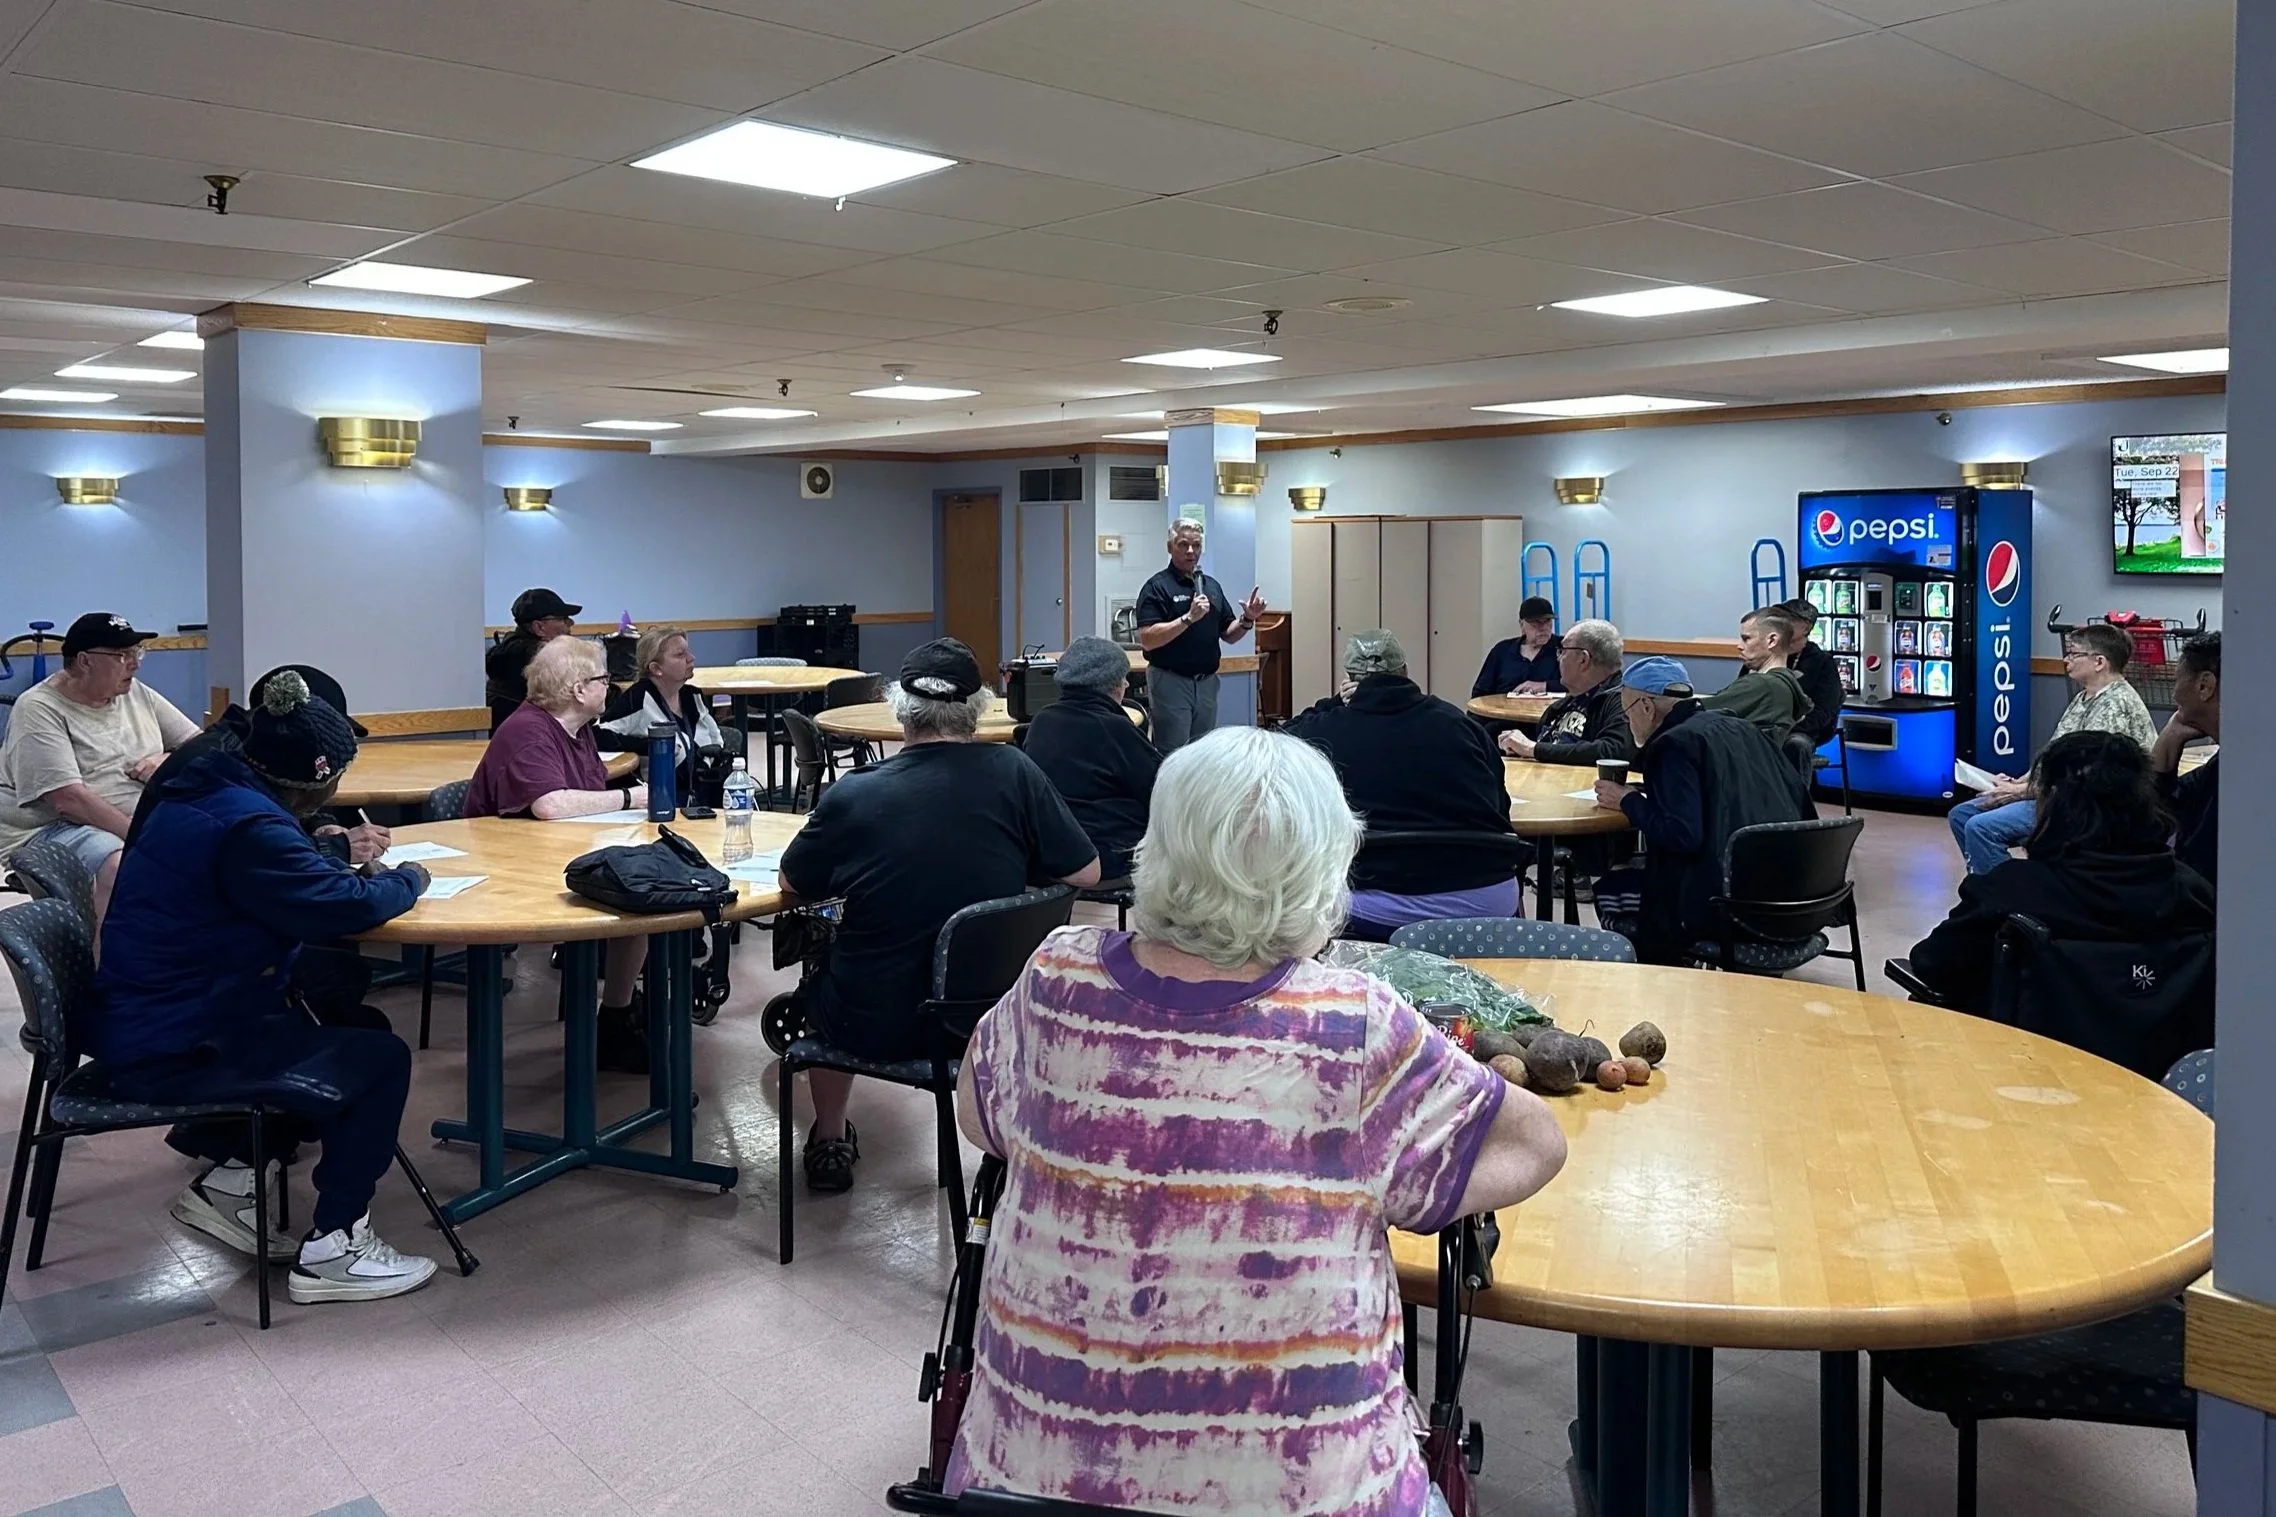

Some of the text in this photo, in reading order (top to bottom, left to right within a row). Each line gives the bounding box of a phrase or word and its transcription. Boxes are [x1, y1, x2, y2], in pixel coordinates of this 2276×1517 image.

[2115, 466, 2179, 478] Tue, Sep 22
